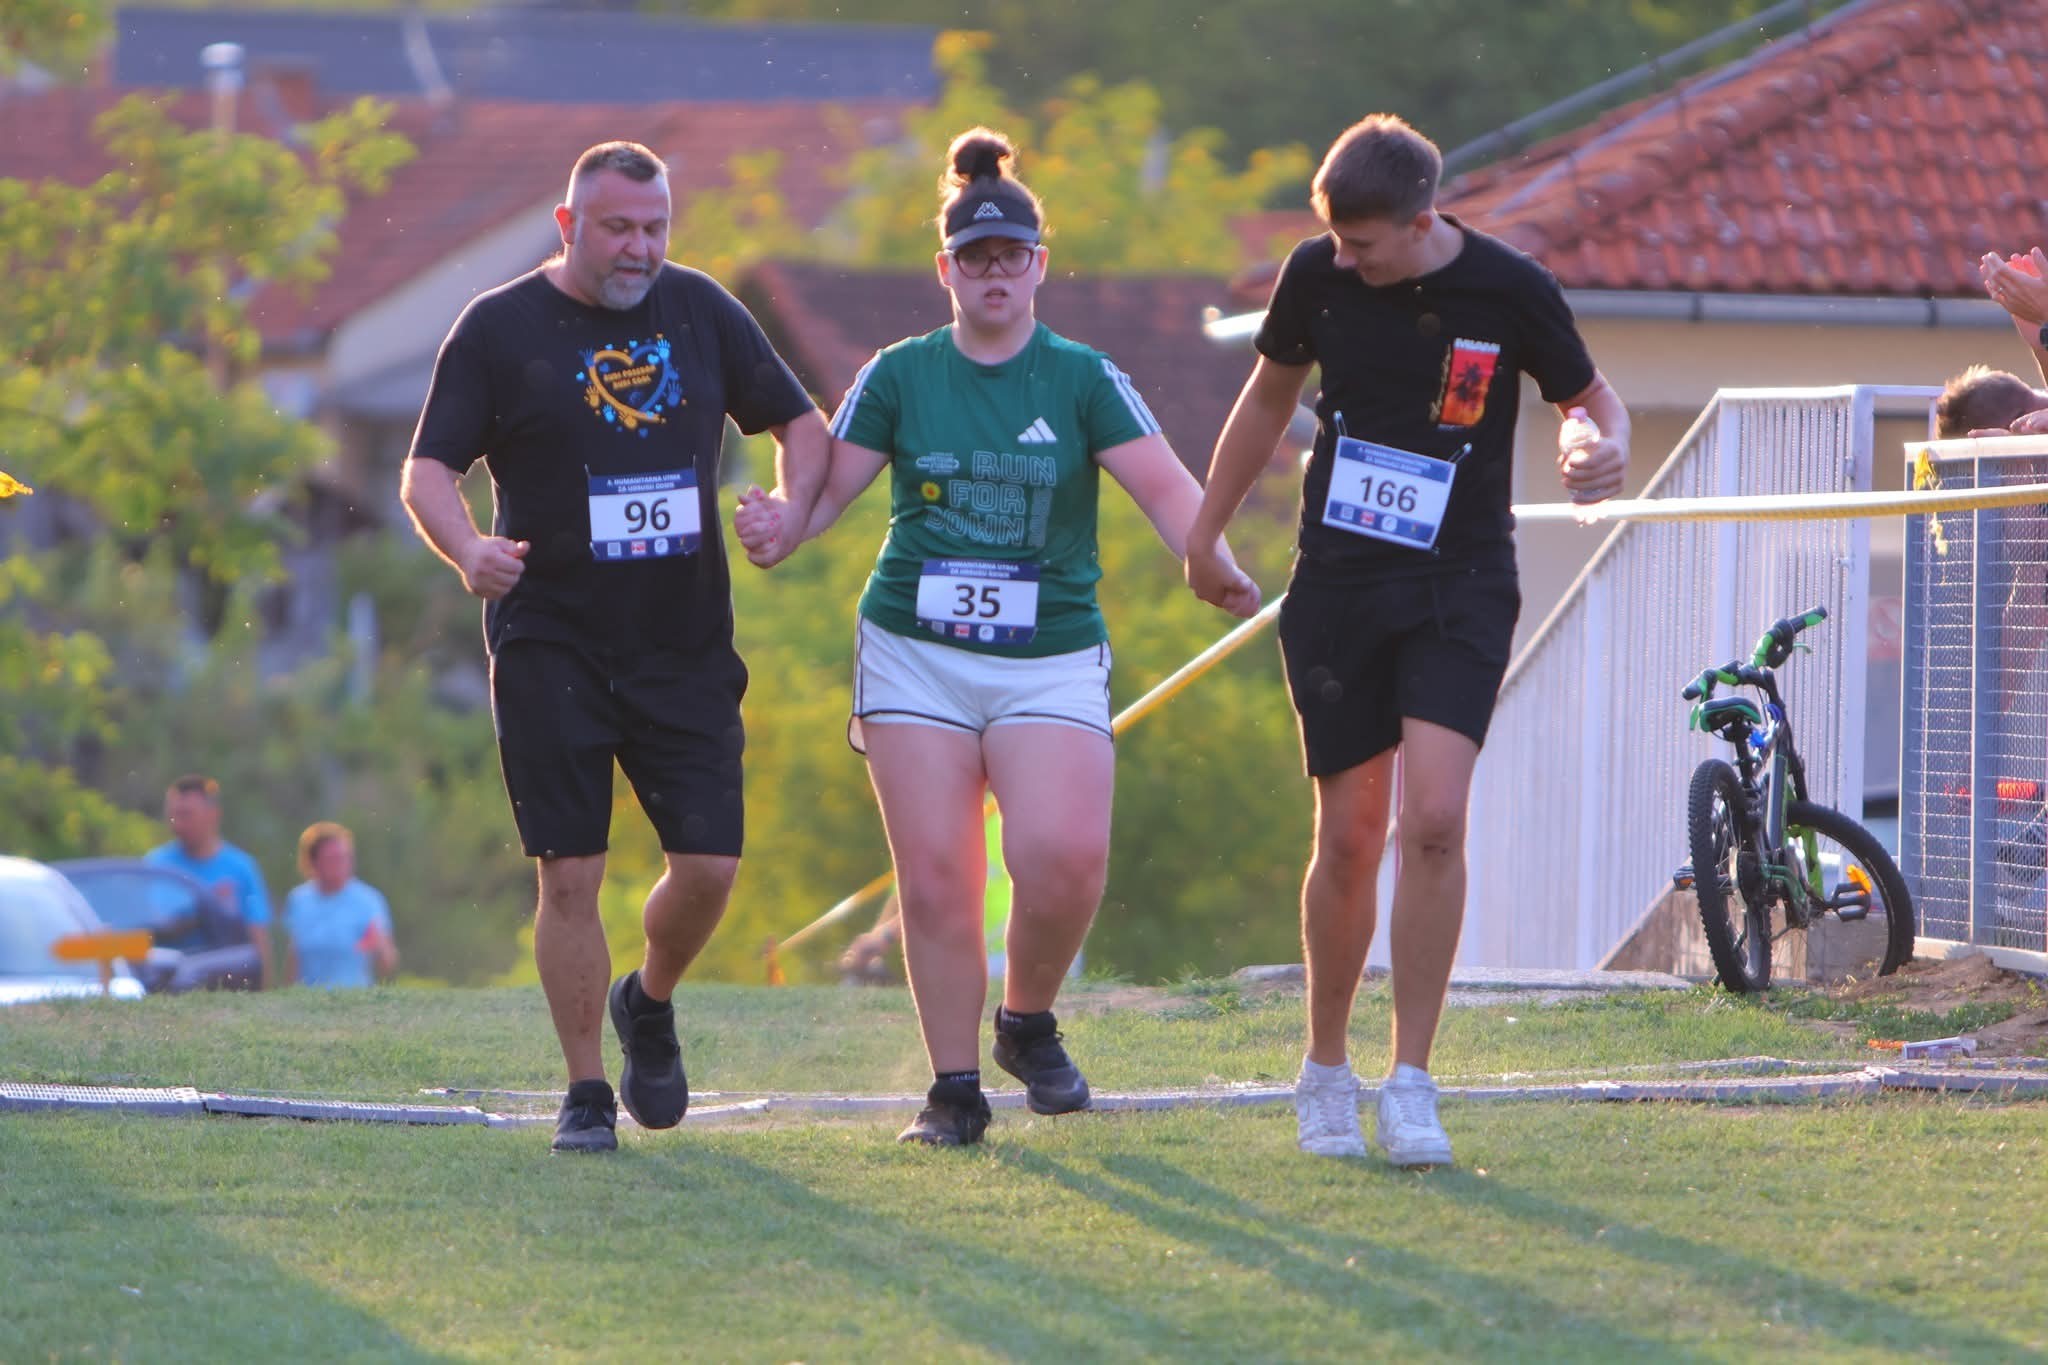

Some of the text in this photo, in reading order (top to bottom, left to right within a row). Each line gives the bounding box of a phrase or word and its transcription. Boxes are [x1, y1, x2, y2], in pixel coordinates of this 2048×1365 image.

[972, 450, 1057, 487] RUN
[949, 479, 1026, 515] FOR
[1360, 475, 1419, 513] 166
[624, 497, 671, 534] 96
[925, 505, 1024, 546] DOWN
[952, 583, 1001, 619] 35
